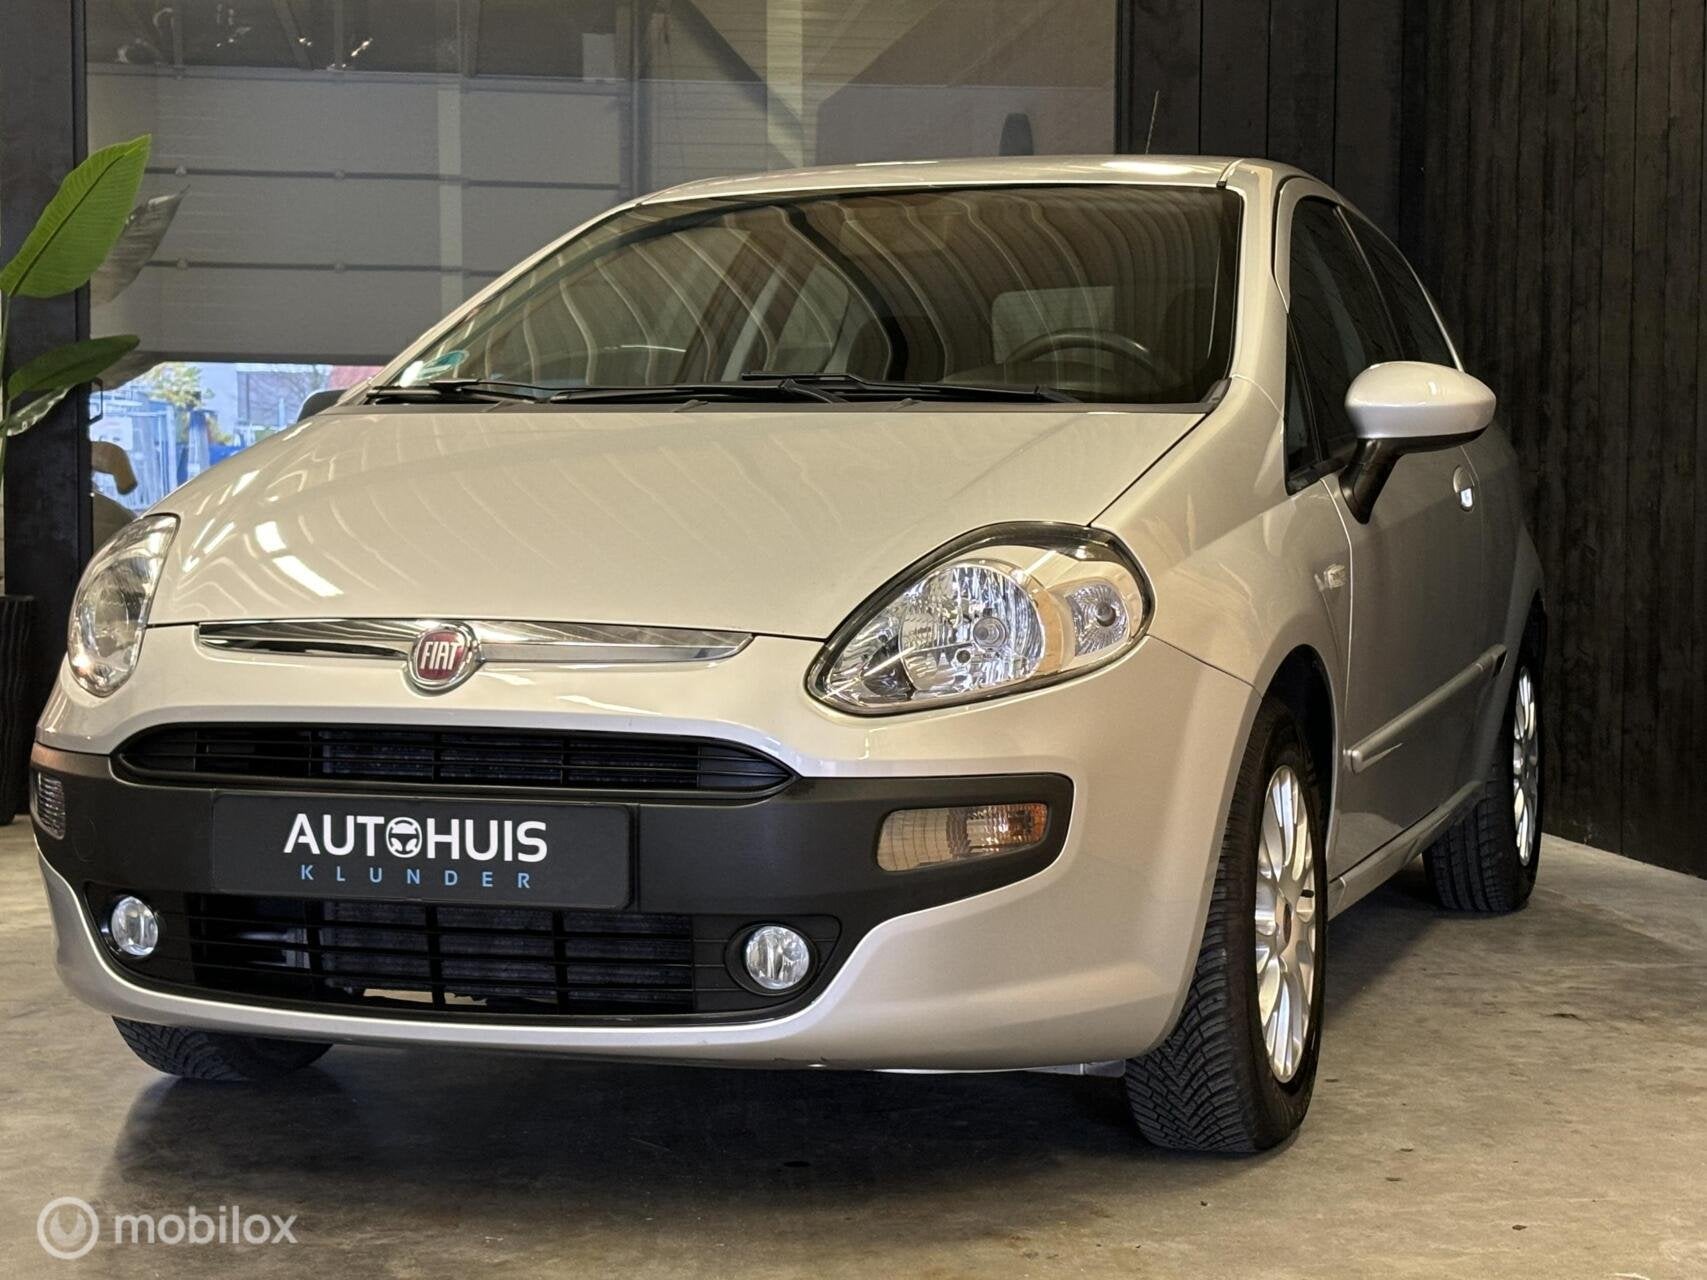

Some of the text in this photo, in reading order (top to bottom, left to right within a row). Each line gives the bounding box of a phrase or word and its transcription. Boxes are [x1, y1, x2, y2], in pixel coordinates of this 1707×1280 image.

[420, 641, 462, 670] FIAT
[283, 813, 548, 862] AUTOHUIS
[300, 864, 531, 889] KLUNDER
